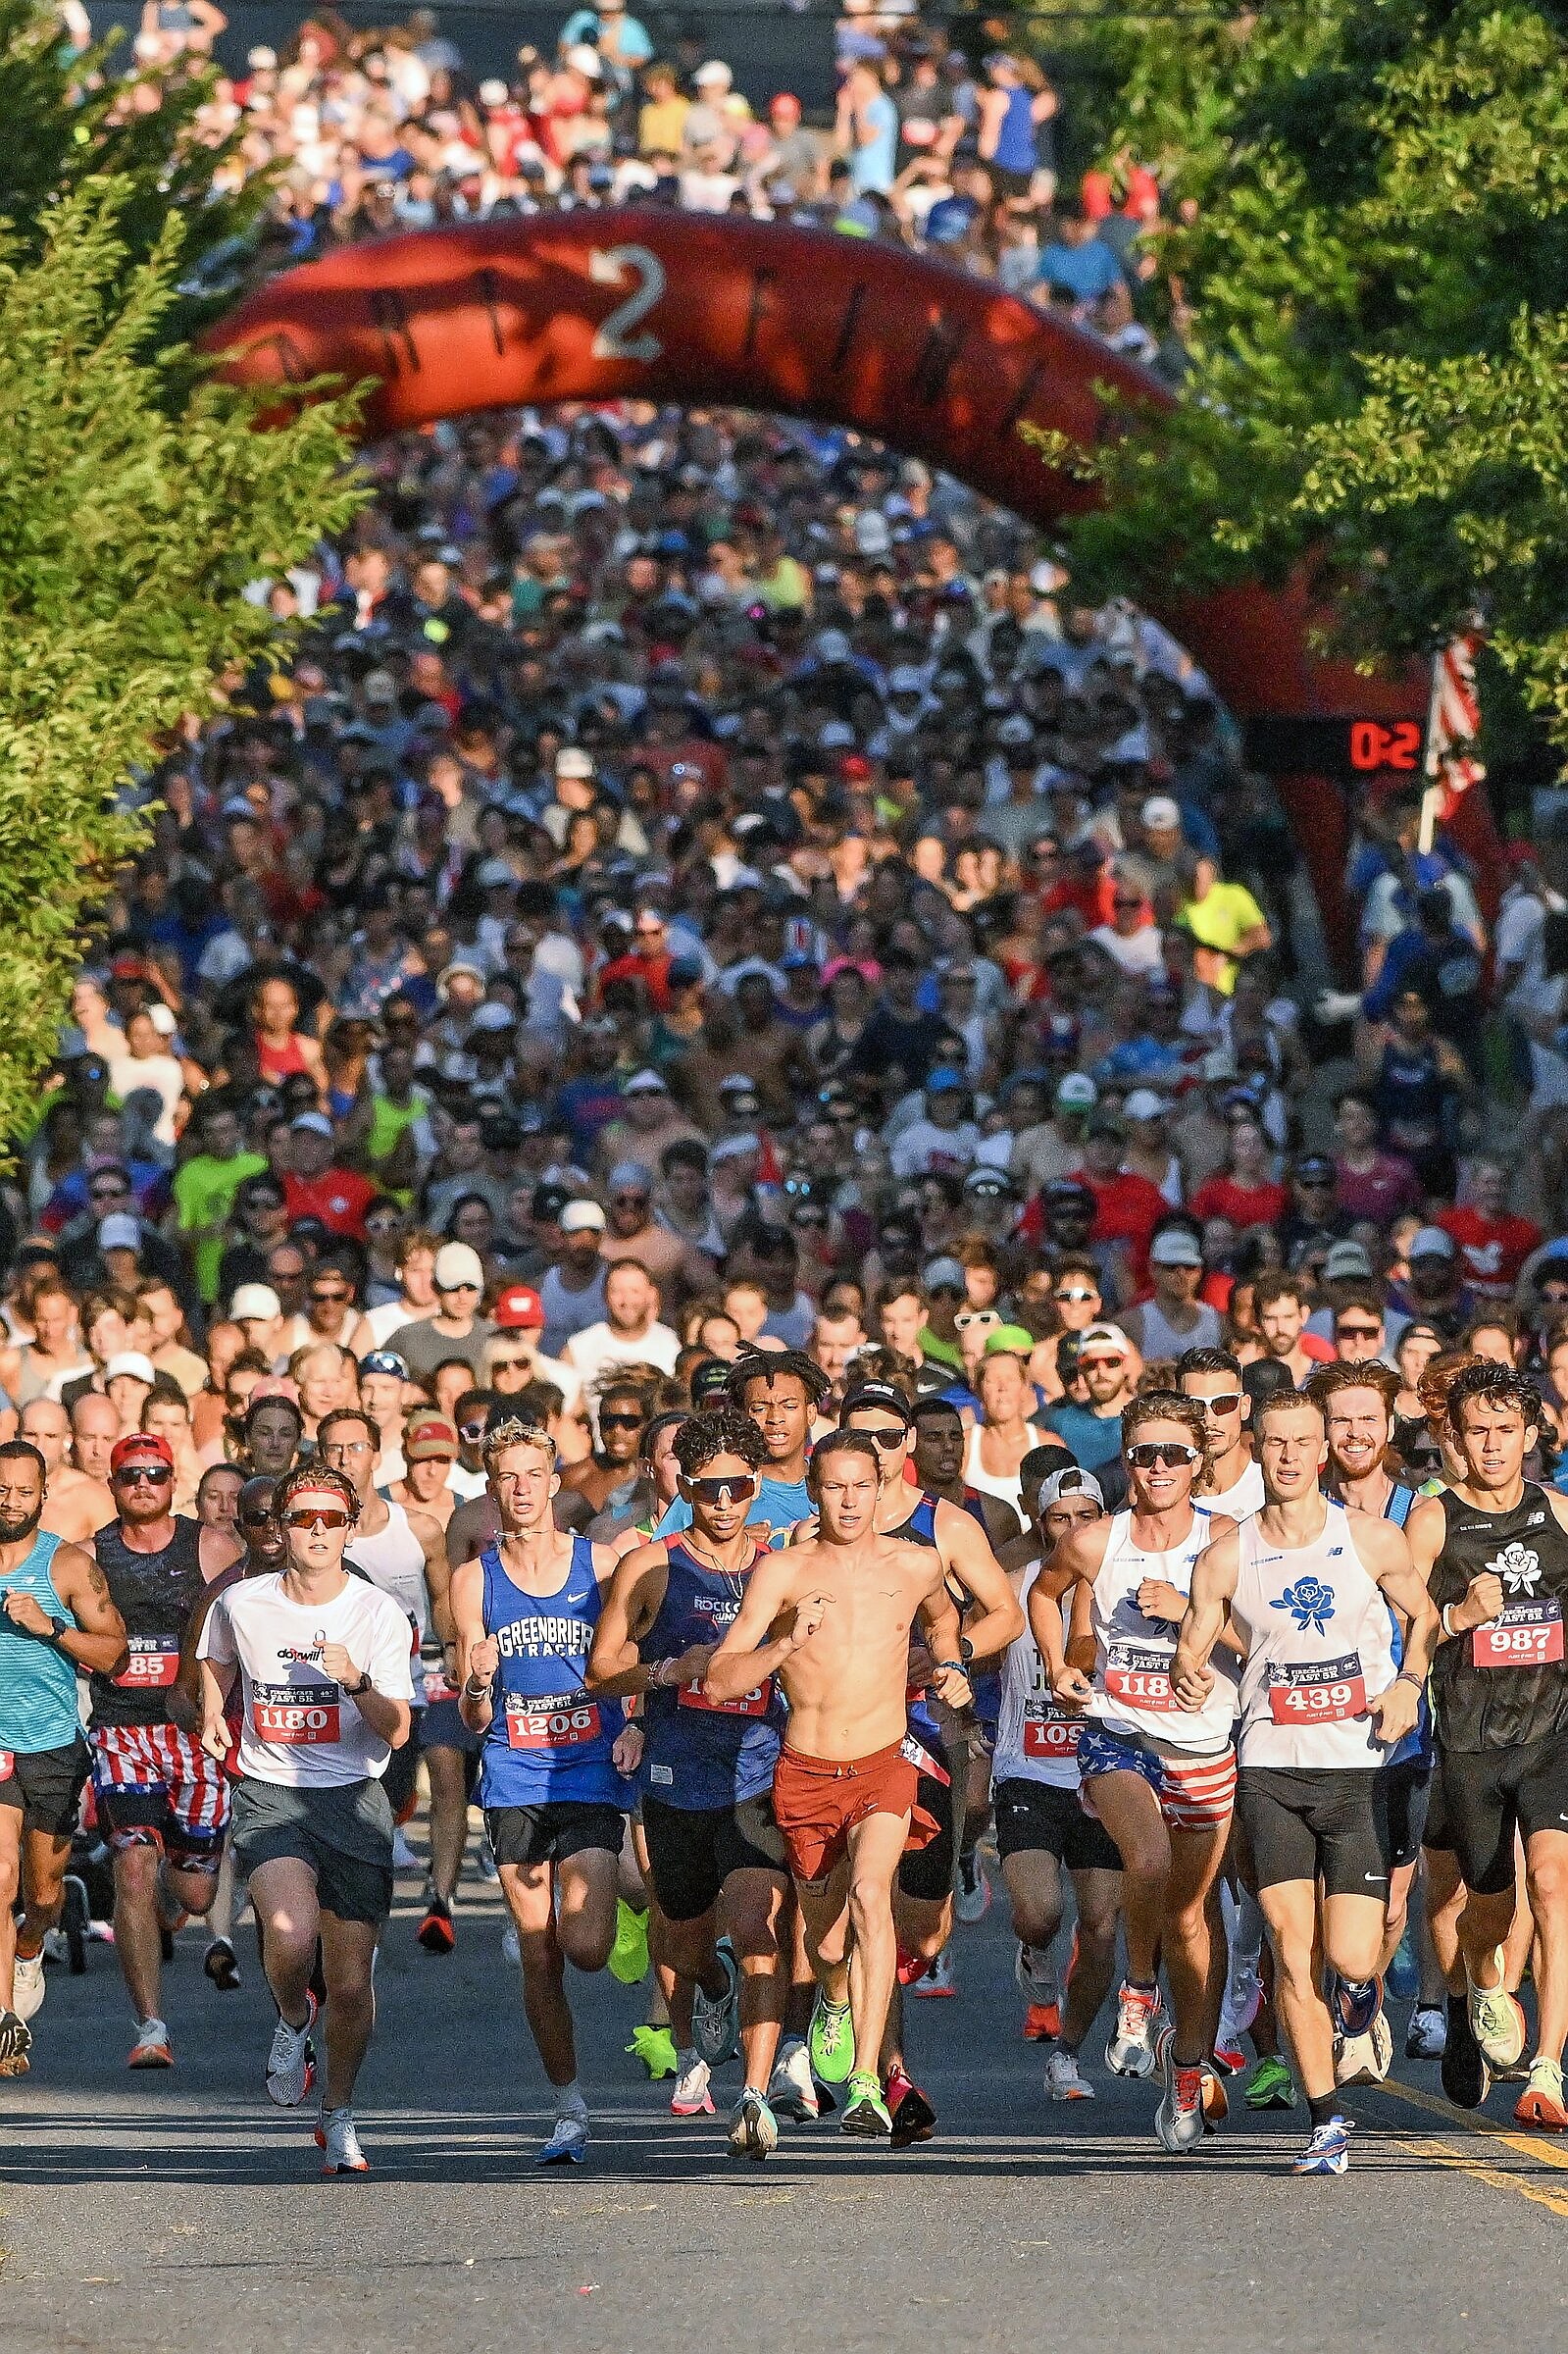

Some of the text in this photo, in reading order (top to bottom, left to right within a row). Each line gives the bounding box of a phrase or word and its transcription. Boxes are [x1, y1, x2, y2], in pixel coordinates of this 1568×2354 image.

[589, 244, 667, 361] 2
[694, 1598, 731, 1613] ROCK
[1498, 1613, 1525, 1622] FAST
[497, 1616, 594, 1658] GREENBRIER
[1490, 1627, 1551, 1653] 987
[515, 1643, 580, 1658] TRACK
[1134, 1661, 1161, 1670] FAST
[1292, 1670, 1340, 1682] FAST 5K
[1119, 1675, 1177, 1698] 118
[271, 1694, 297, 1703] FAST
[1285, 1684, 1352, 1711] 439
[529, 1702, 555, 1712] FAST
[260, 1709, 328, 1730] 1180
[514, 1710, 591, 1737] 1206
